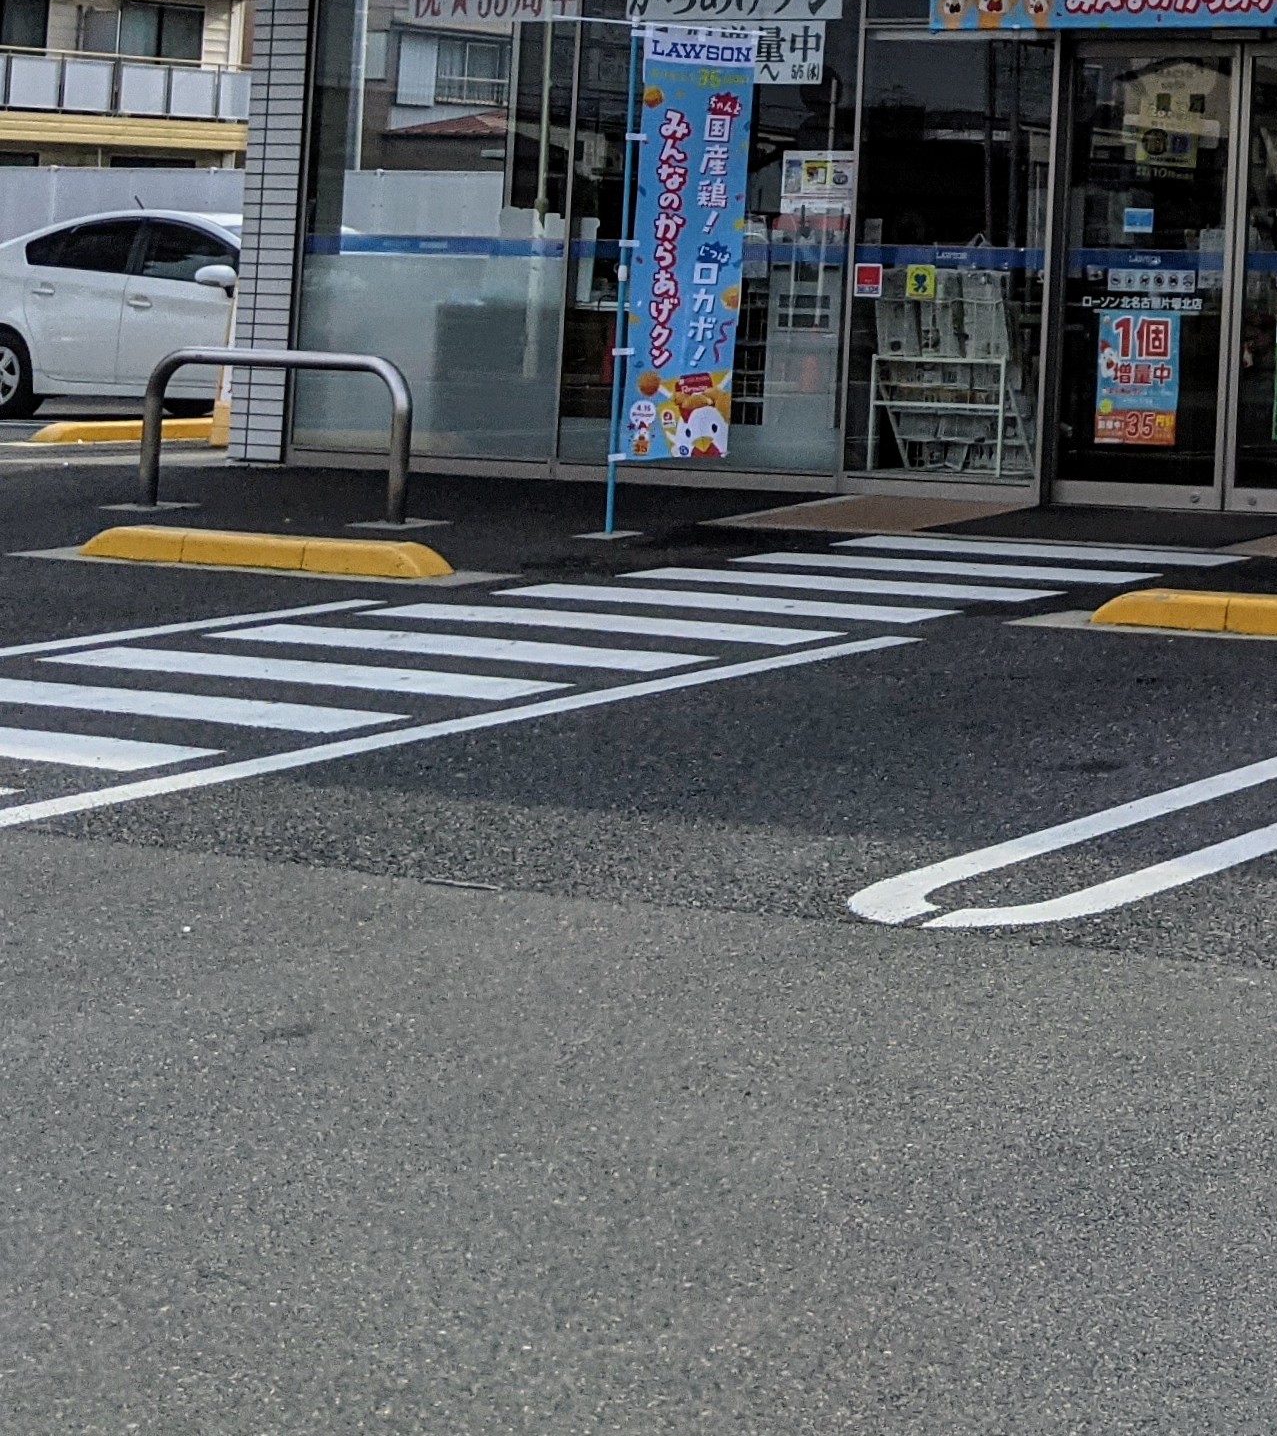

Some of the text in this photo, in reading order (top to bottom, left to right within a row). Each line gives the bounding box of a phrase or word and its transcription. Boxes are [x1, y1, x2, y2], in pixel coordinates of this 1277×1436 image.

[652, 40, 752, 62] LAWSON
[709, 95, 742, 115] ちゃんと
[649, 109, 691, 368] みんなのからあげクン
[699, 245, 730, 264] じつは
[1113, 316, 1171, 360] 1個
[1113, 361, 1172, 385] 増量中
[1126, 411, 1154, 438] 35
